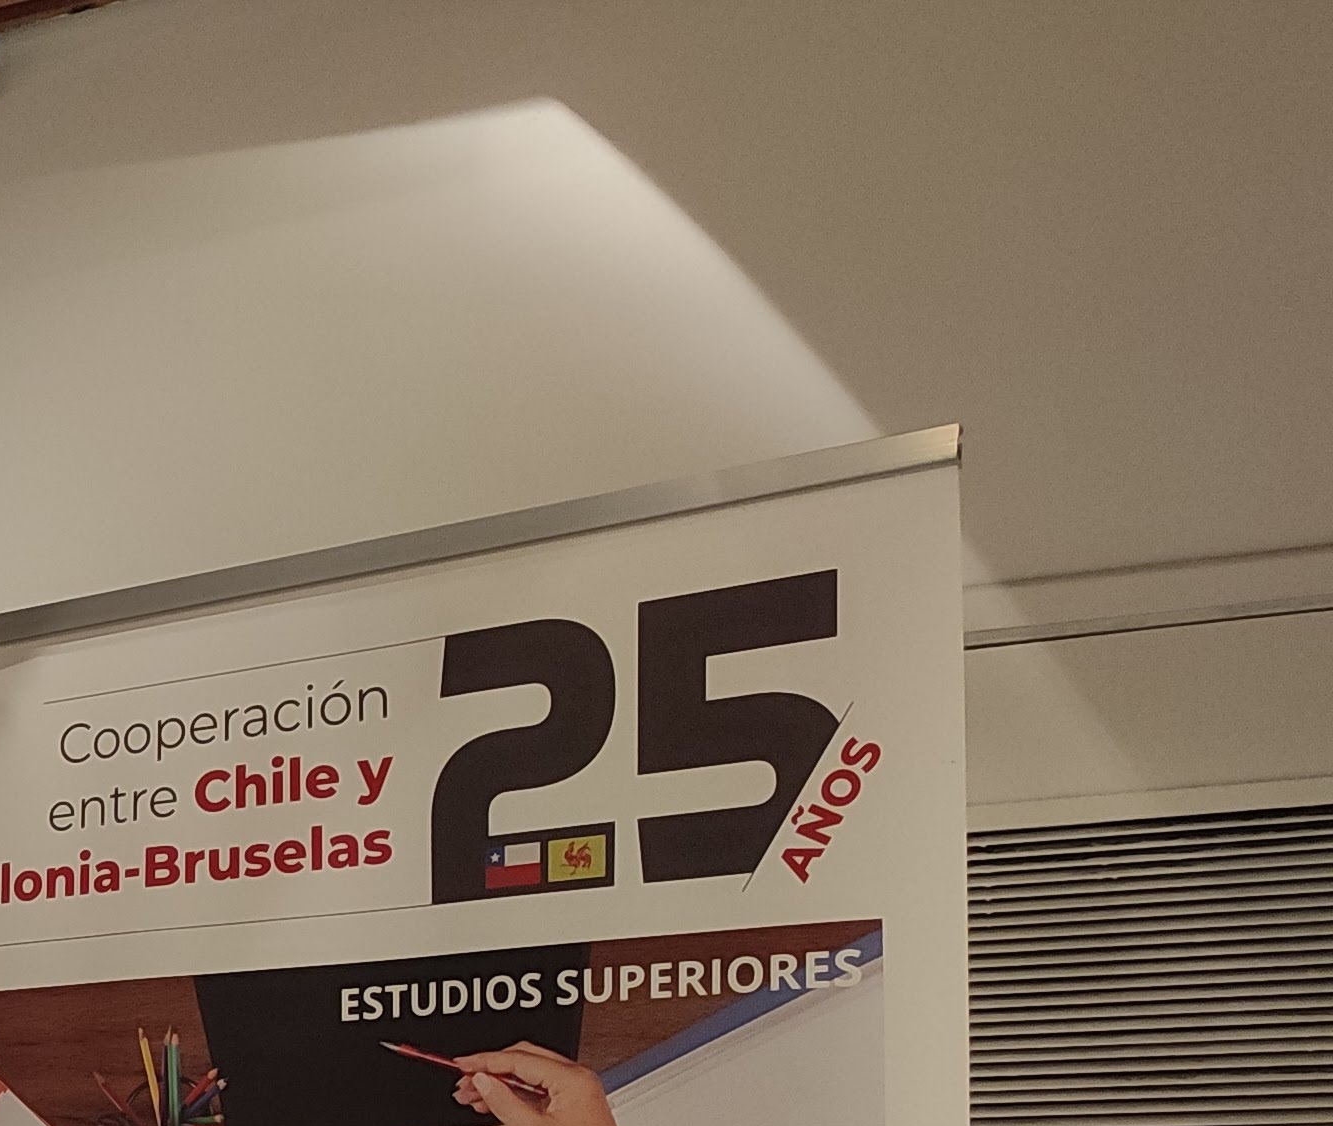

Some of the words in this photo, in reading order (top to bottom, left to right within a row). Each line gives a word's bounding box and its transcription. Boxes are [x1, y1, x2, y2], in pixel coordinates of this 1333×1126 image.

[59, 677, 389, 766] Cooperación
[431, 568, 840, 905] 25
[47, 780, 179, 834] entre
[193, 757, 337, 816] Chile
[354, 748, 395, 806] y
[777, 735, 884, 885] AÑOS
[338, 972, 543, 1023] ESTUDIOS
[554, 948, 865, 1006] SUPERIORES
